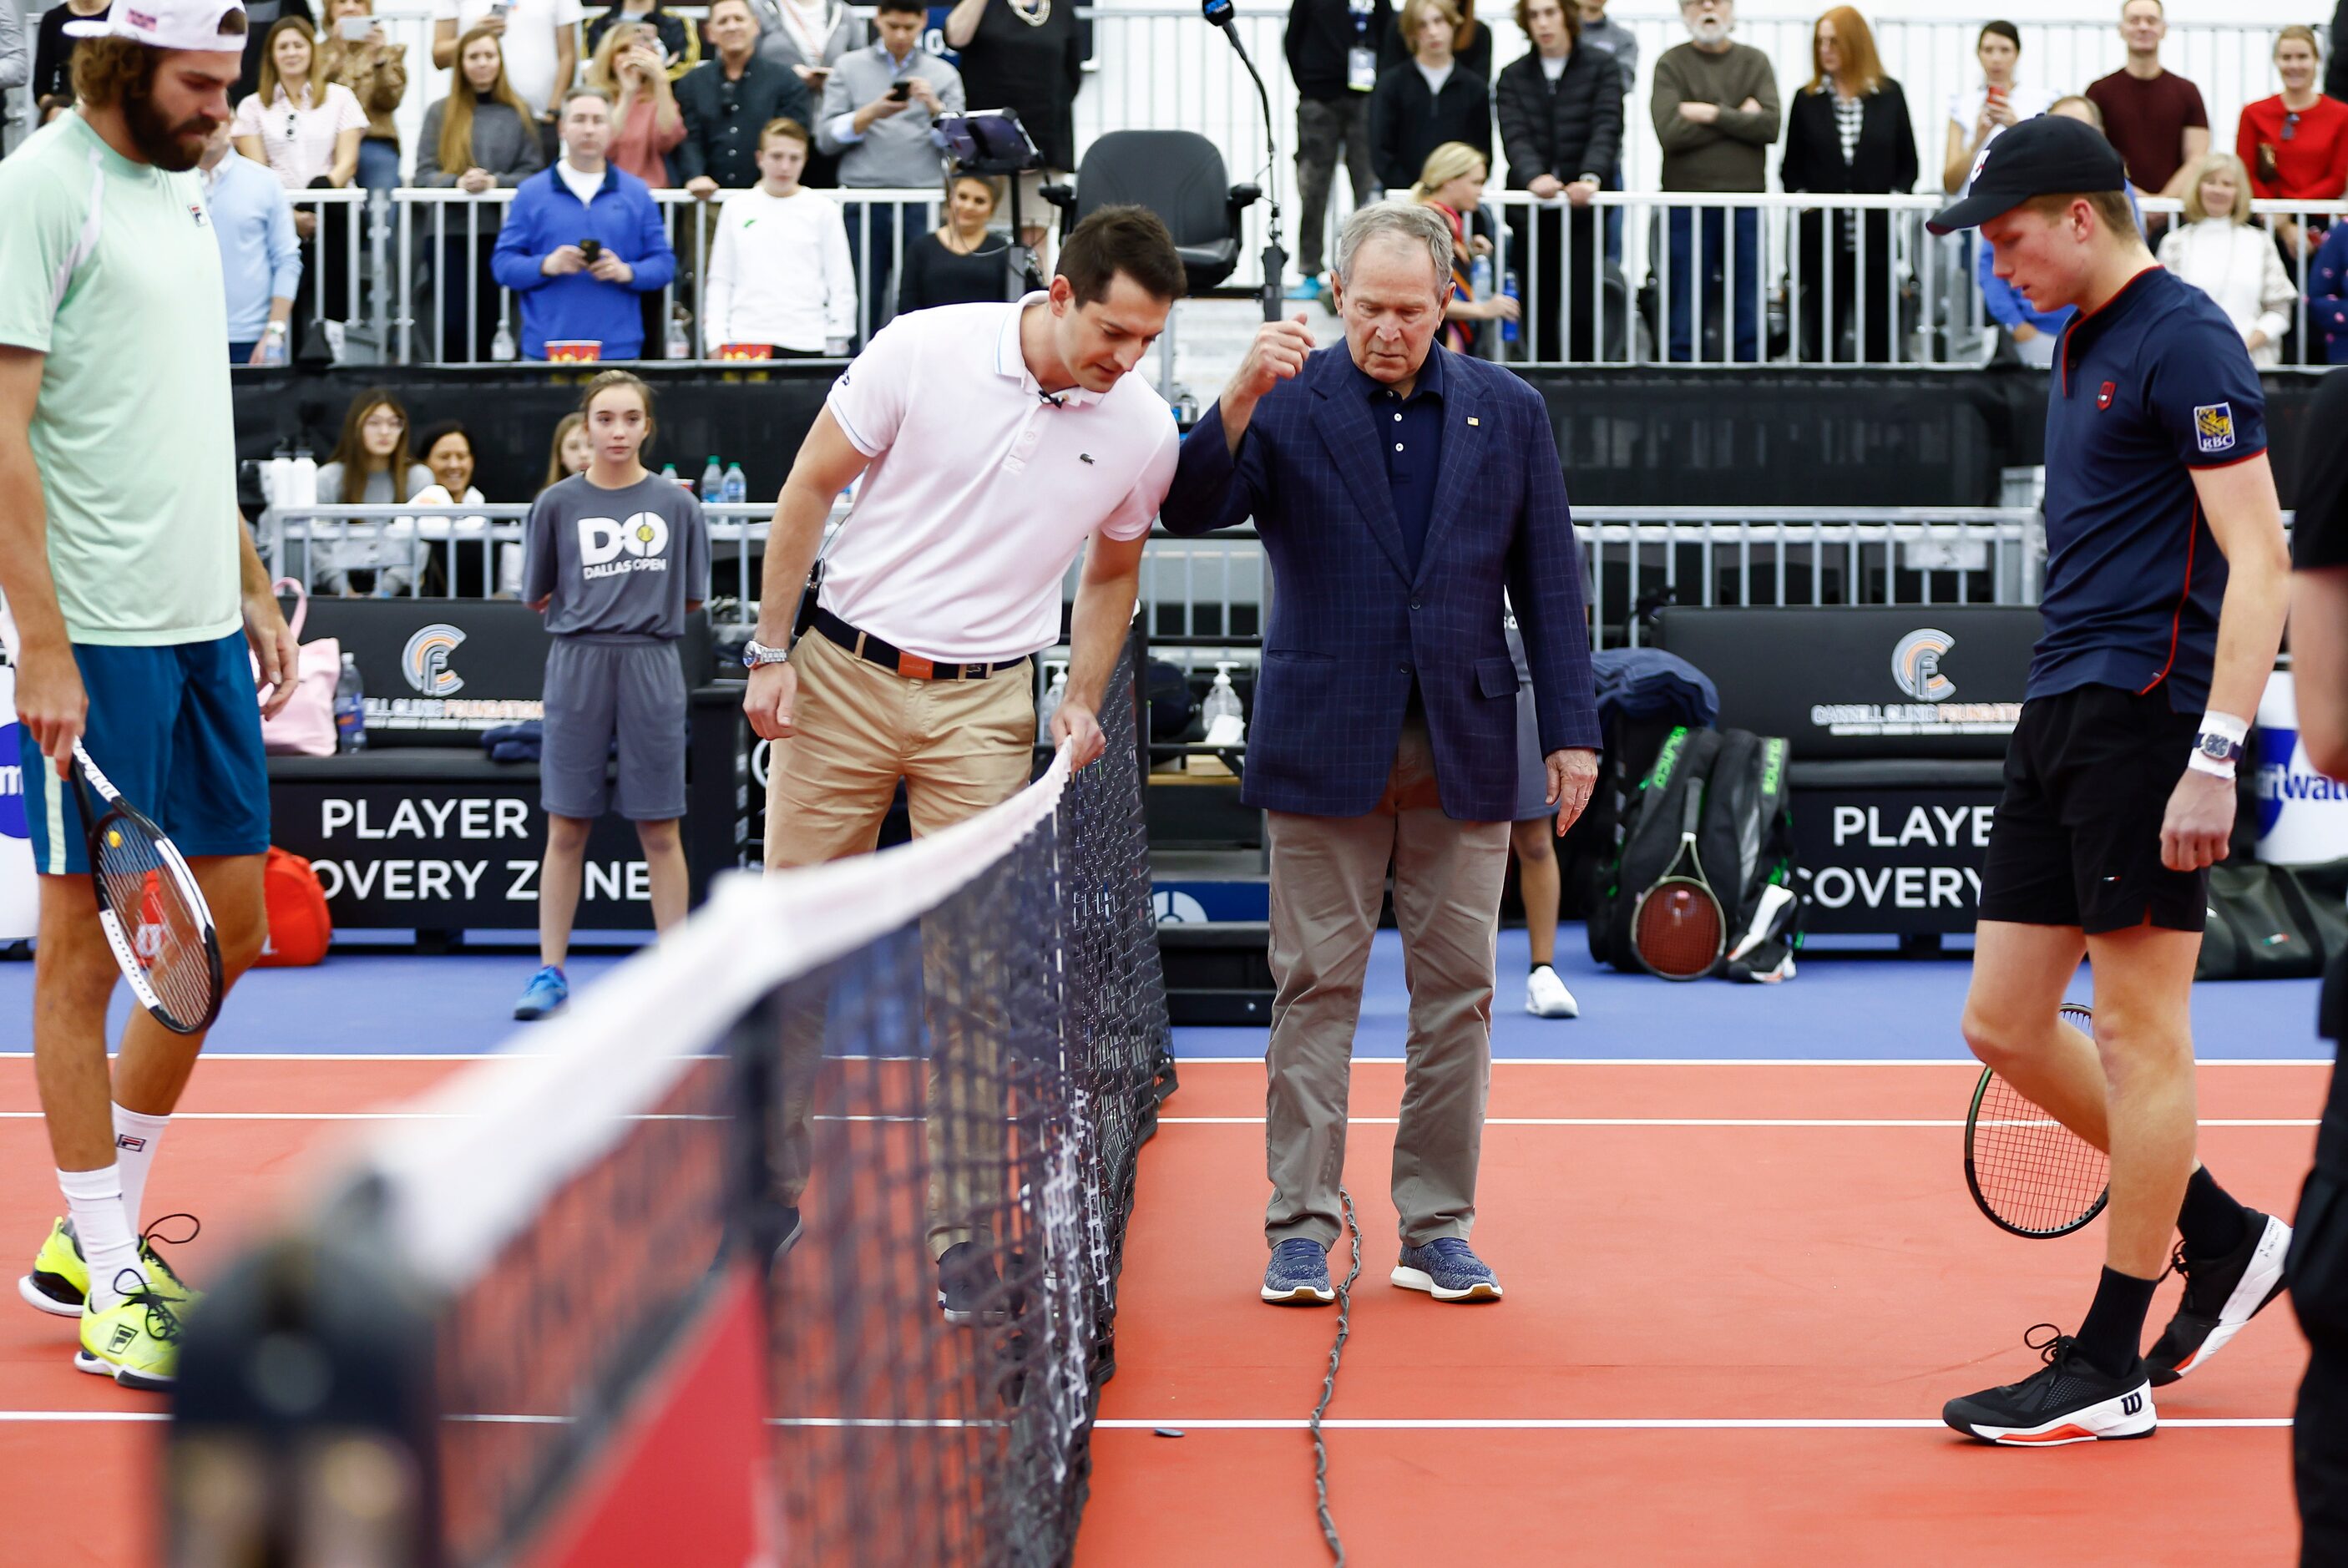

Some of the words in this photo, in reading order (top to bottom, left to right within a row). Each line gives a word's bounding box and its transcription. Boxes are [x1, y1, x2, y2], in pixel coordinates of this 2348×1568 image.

[2203, 434, 2232, 448] RBC
[583, 559, 631, 580] DALLAS
[632, 558, 666, 571] OPEN
[321, 798, 529, 839] PLAYER
[1833, 805, 1996, 847] PLAYE
[310, 859, 489, 900] OVERY
[505, 860, 651, 901] ZNE
